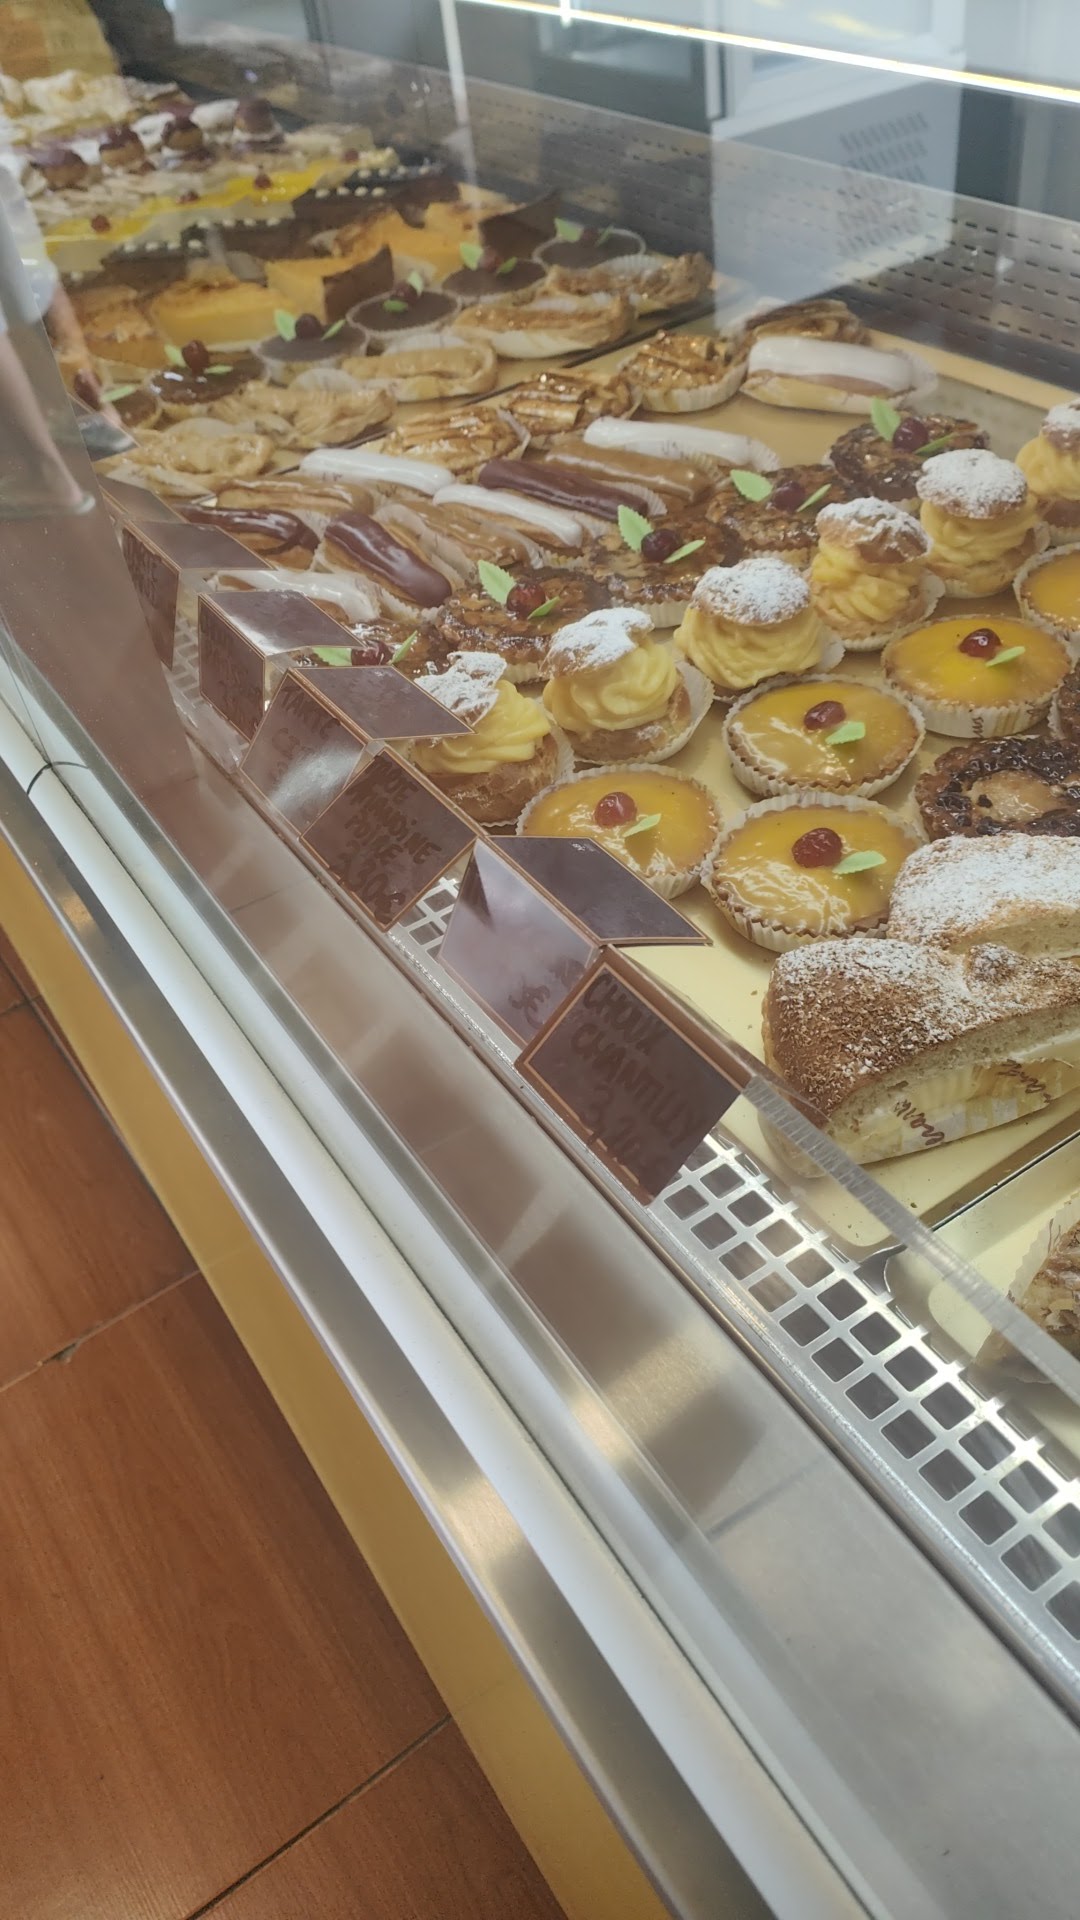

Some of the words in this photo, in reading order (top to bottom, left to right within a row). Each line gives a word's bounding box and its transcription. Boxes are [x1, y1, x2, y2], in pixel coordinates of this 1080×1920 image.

[344, 808, 404, 864] POIRE
[345, 780, 441, 864] AMANDINE
[583, 973, 667, 1056] CHOUX
[570, 1023, 708, 1149] CHANTILLY
